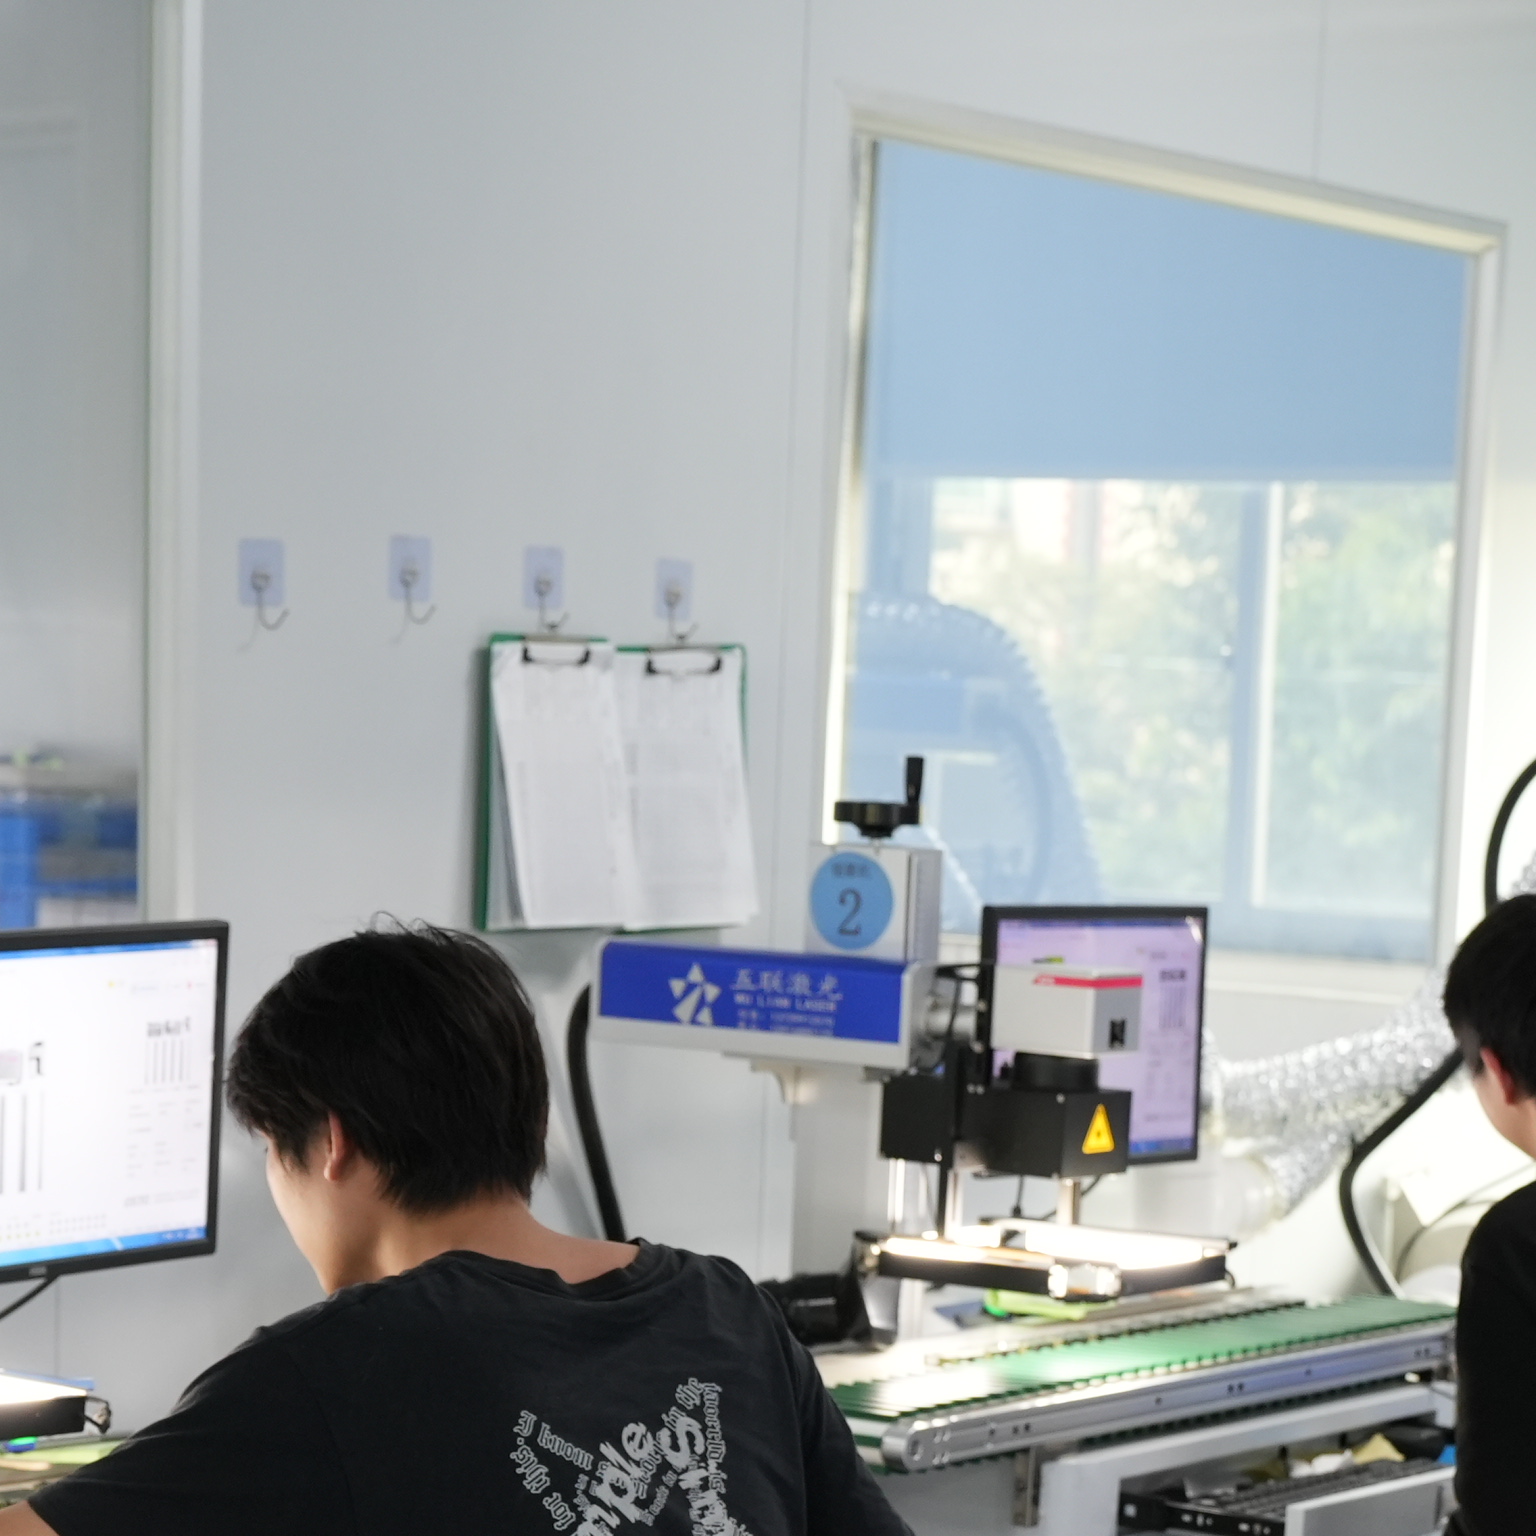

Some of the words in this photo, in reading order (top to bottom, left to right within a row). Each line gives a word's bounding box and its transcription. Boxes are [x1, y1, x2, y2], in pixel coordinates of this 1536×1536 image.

[838, 887, 862, 936] 2
[732, 969, 843, 1001] 五联激光
